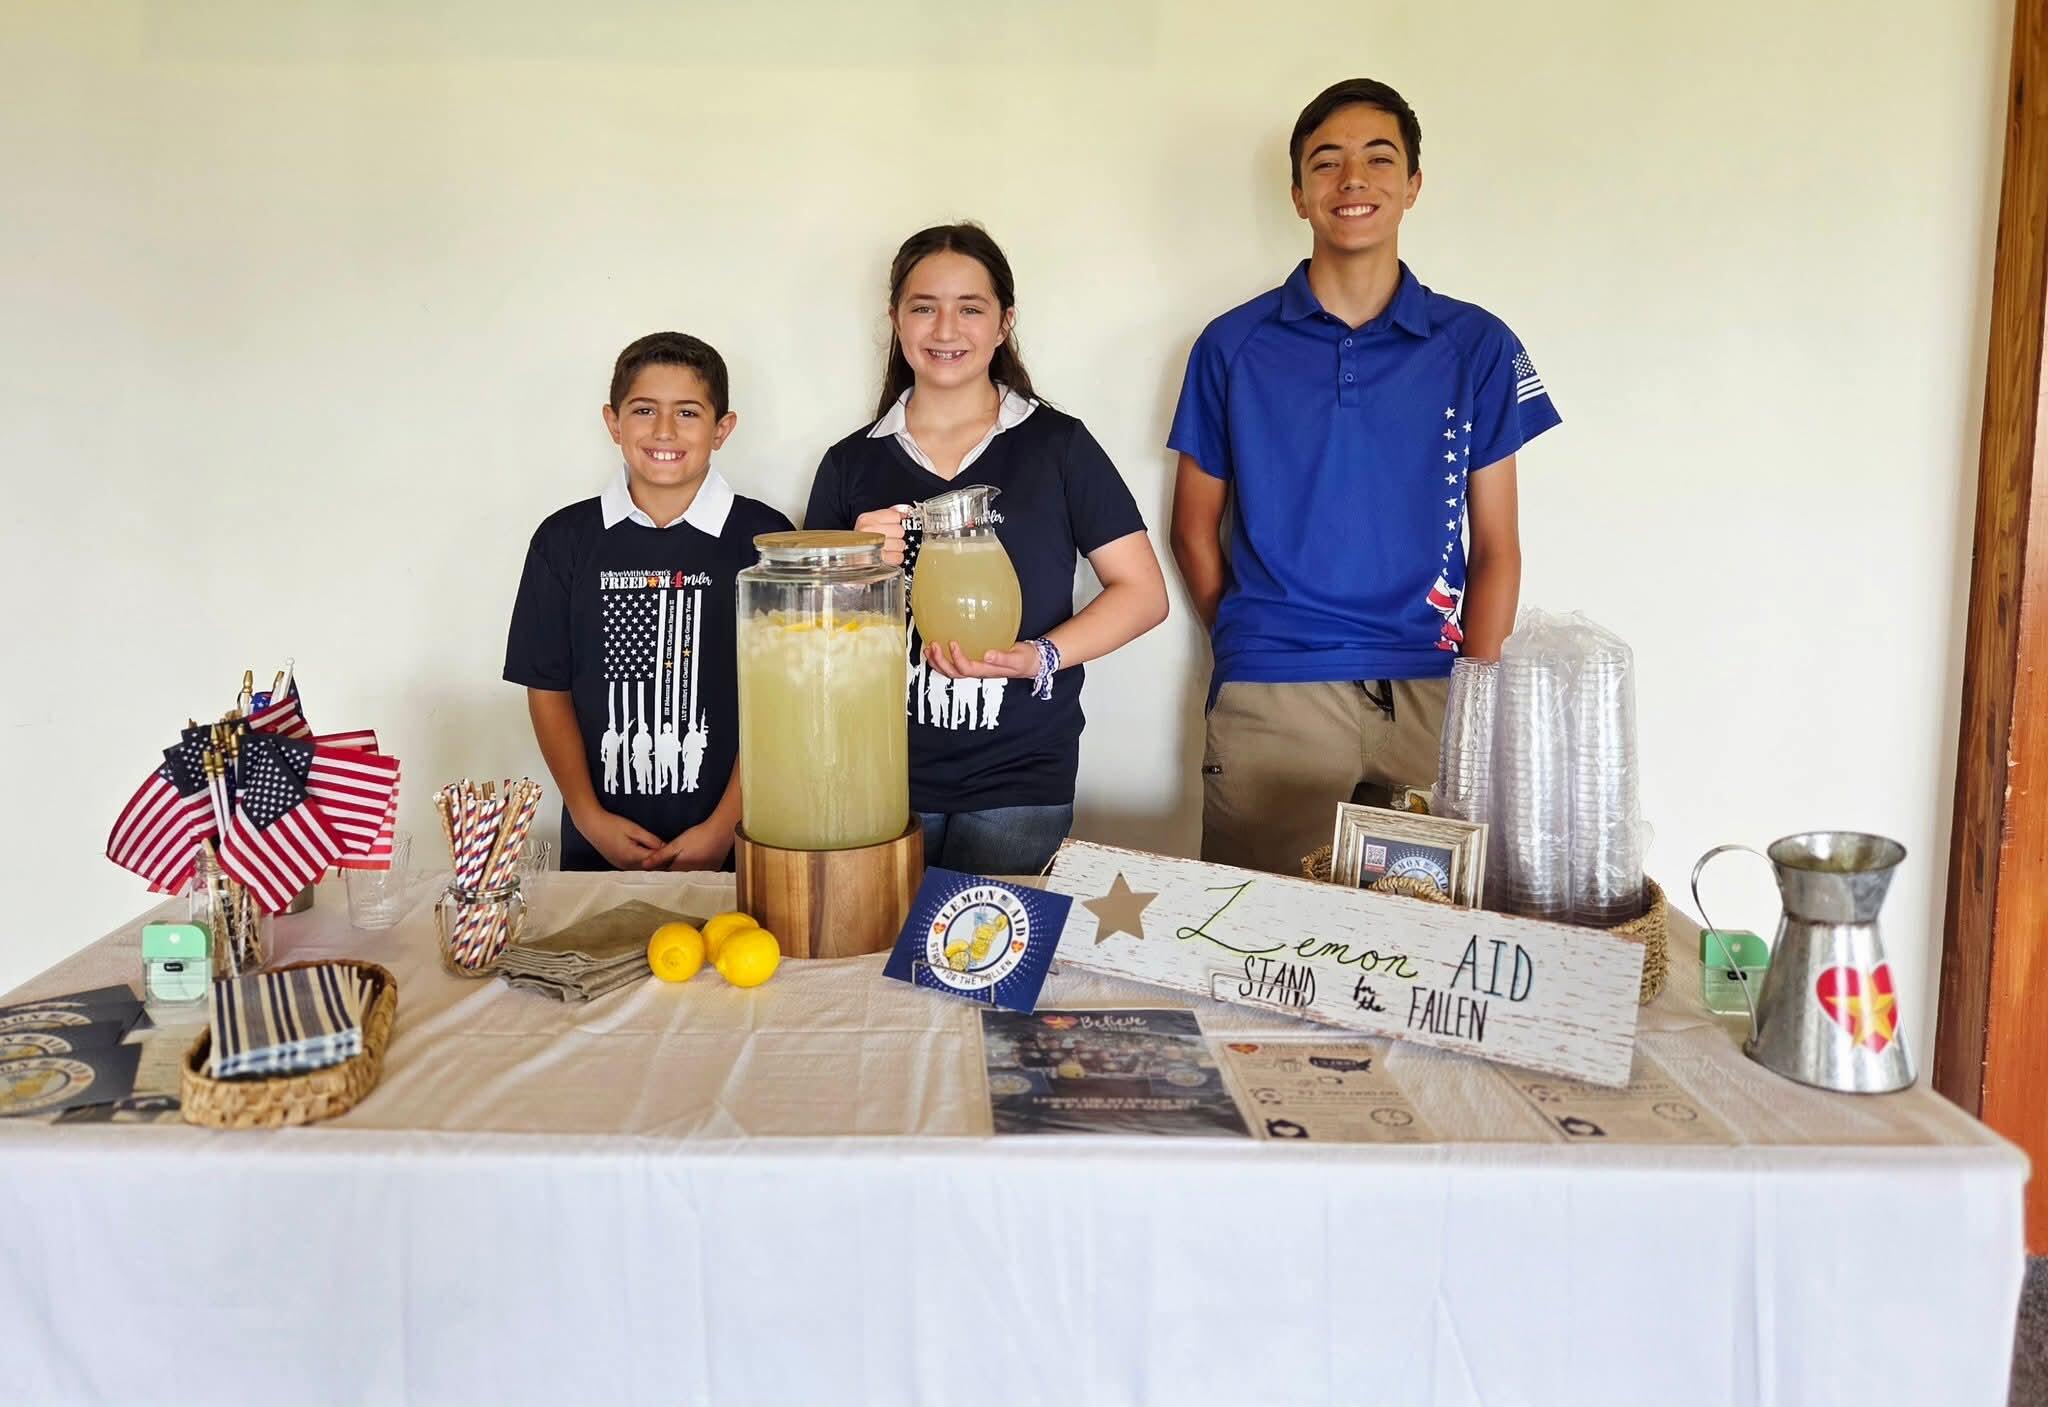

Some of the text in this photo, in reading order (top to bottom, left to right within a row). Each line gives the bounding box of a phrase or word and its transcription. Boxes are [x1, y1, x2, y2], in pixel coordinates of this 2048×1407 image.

[671, 570, 683, 589] 4
[1391, 859, 1420, 876] EMON
[942, 889, 1026, 937] LEMON AID
[1176, 878, 1532, 1002] Lemon AID
[960, 976, 977, 985] THE
[1238, 954, 1316, 1007] STAND
[1407, 986, 1488, 1043] FALLEN
[1079, 1014, 1148, 1031] Believe
